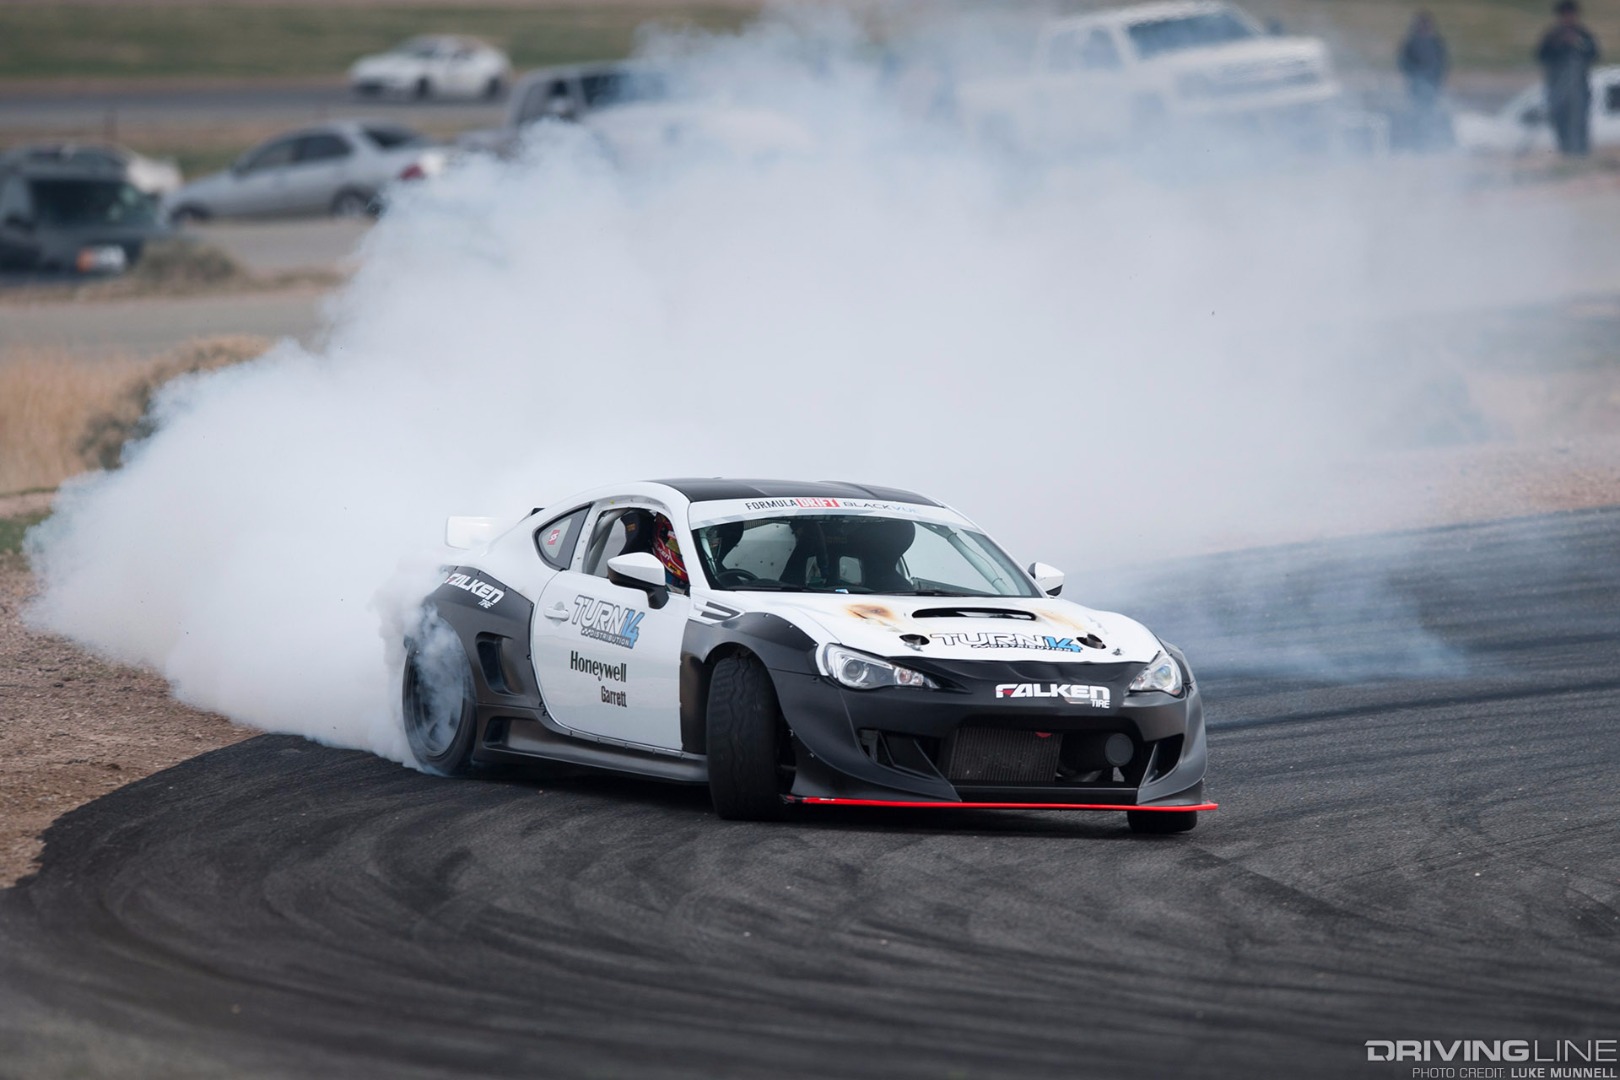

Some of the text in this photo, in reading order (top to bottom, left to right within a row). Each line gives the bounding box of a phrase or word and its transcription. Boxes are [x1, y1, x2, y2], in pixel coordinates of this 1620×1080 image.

[745, 498, 841, 511] FORMULA DRIFT
[444, 572, 505, 604] FALKEN
[570, 650, 627, 682] Honeywell
[600, 685, 628, 708] Garrett
[995, 683, 1111, 700] FALKEN
[1091, 699, 1110, 709] TIRE
